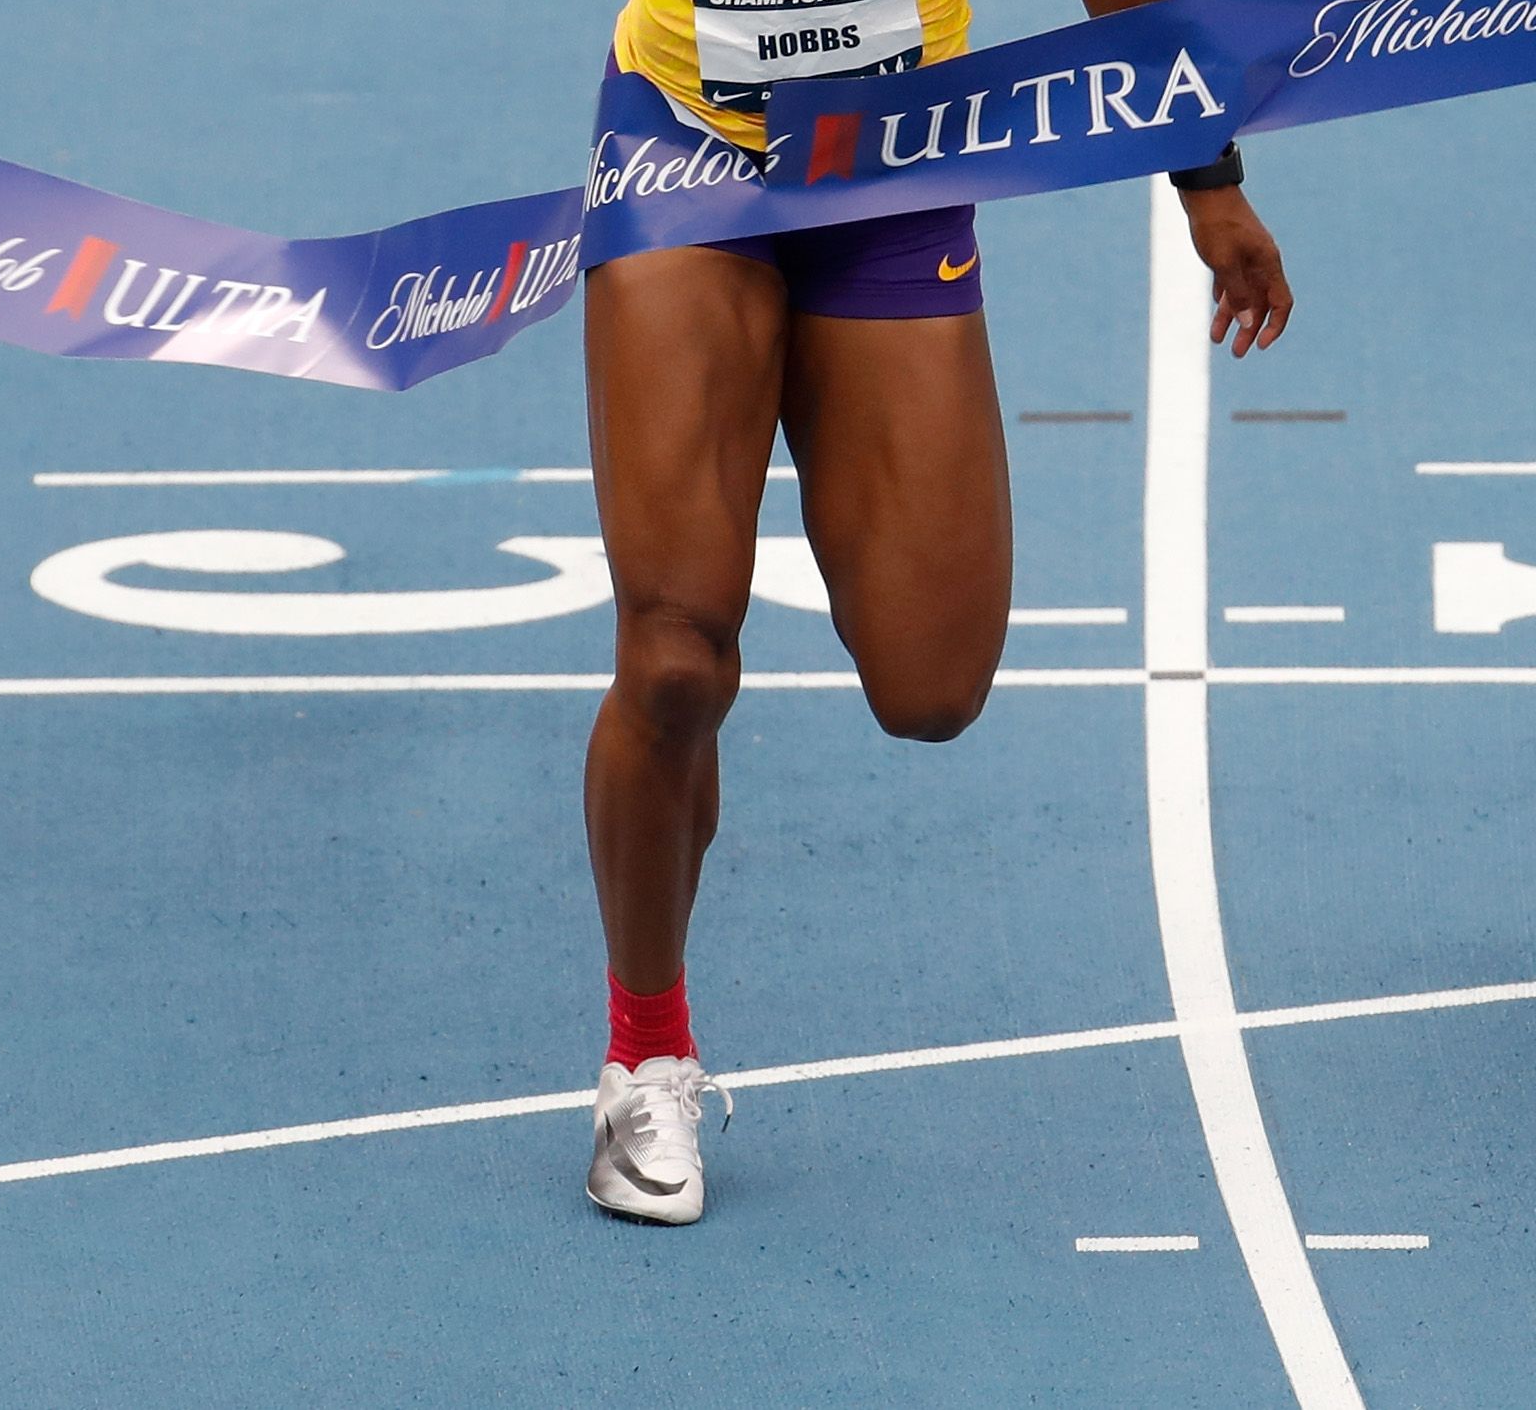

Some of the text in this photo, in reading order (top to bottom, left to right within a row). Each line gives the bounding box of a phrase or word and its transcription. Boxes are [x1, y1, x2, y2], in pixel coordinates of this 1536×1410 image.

[757, 25, 861, 61] HOBBS
[878, 47, 1225, 168] ULTRA
[103, 258, 328, 343] ULTRA
[366, 265, 502, 350] Michelob
